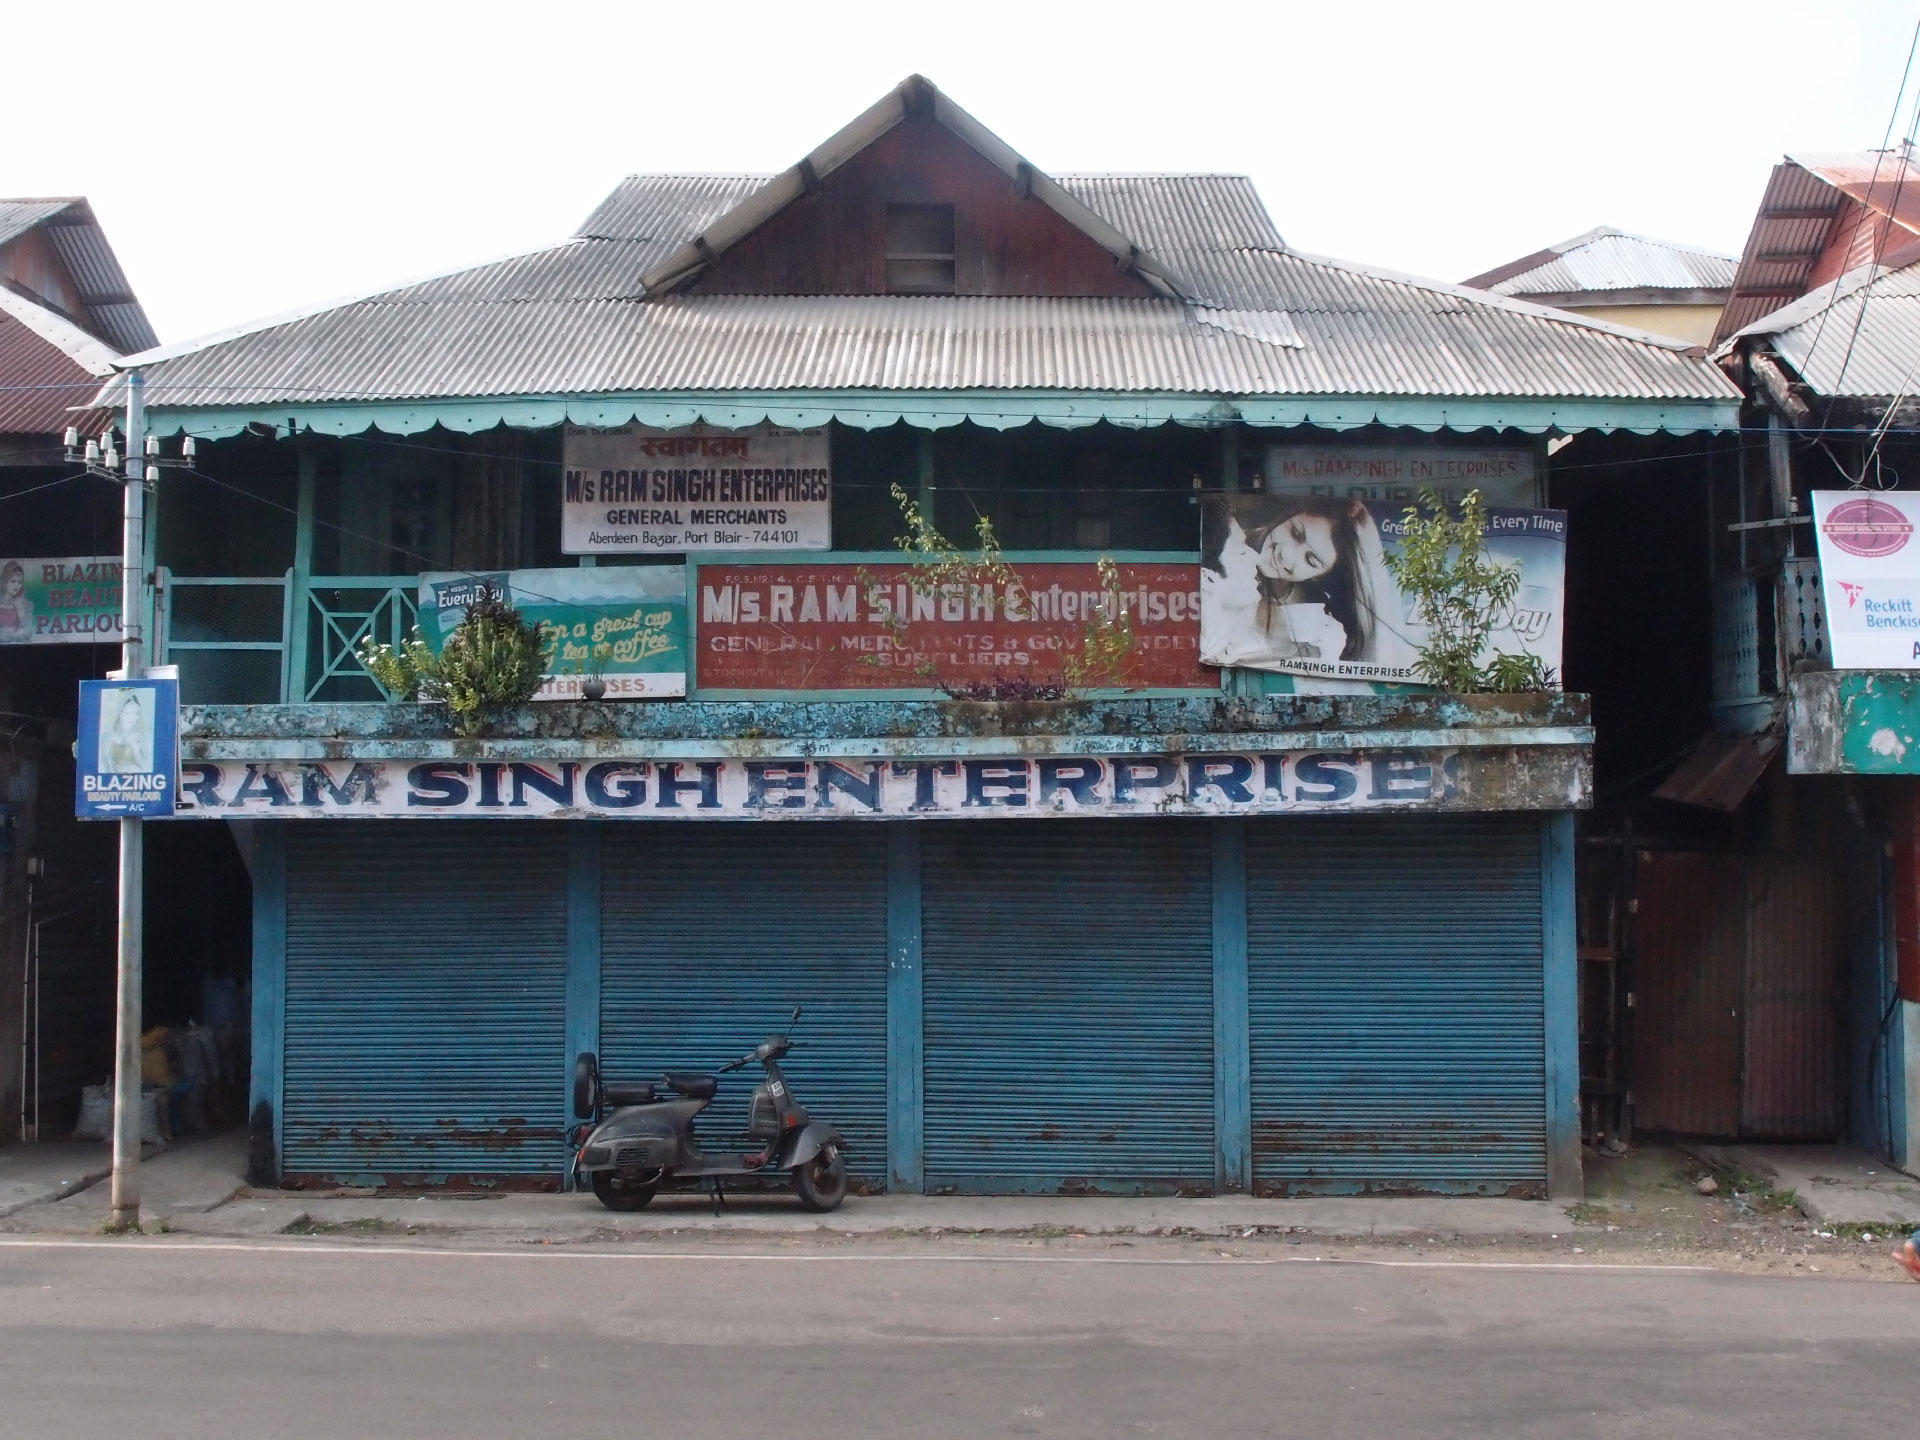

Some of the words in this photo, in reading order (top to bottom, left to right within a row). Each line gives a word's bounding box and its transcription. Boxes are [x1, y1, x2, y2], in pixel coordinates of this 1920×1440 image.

[566, 470, 595, 503] M/s
[601, 470, 648, 502] RAM
[652, 469, 715, 502] SINGH
[720, 468, 827, 501] ENTERPRISES
[607, 510, 683, 525] GENERAL
[690, 509, 787, 525] MERCHANTS
[1493, 515, 1529, 531] Every
[1532, 515, 1564, 533] Time
[588, 530, 638, 545] Aberdeen
[684, 530, 709, 544] Port
[753, 530, 798, 544] 744101
[42, 562, 123, 584] BLAZIN
[48, 587, 123, 608] BEAUT
[703, 585, 760, 624] M/s
[770, 584, 857, 623] RAM
[868, 584, 994, 622] SINGH
[1864, 599, 1913, 613] Reckitt
[35, 613, 123, 634] PARLOU
[572, 623, 587, 638] a
[592, 609, 642, 642] great
[645, 611, 672, 631] cup
[561, 641, 589, 660] tea
[613, 629, 669, 662] coffee
[1280, 659, 1334, 674] RAMSINGH
[1338, 665, 1412, 678] ENTERPRISES
[83, 774, 167, 792] BLAZING
[182, 762, 388, 806] RAM
[406, 761, 725, 808] SINGH
[128, 803, 145, 811] A/C
